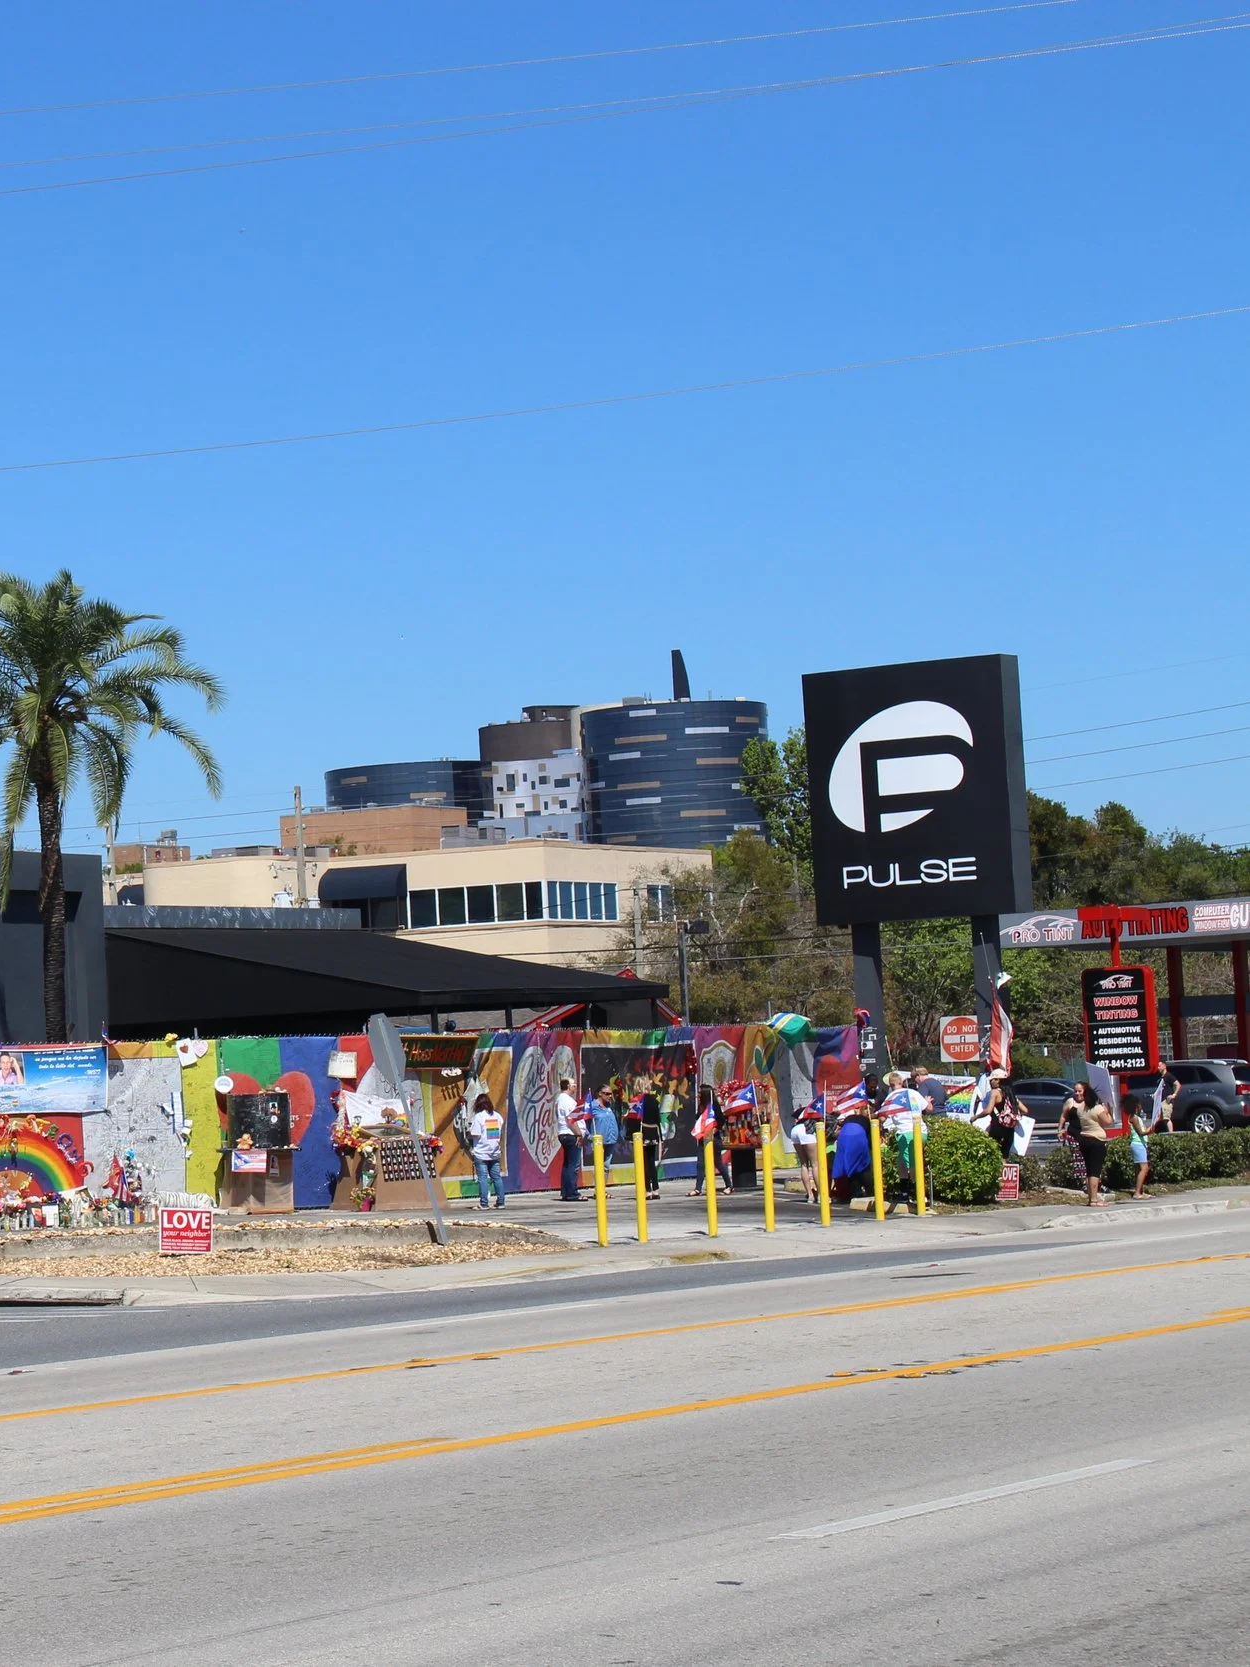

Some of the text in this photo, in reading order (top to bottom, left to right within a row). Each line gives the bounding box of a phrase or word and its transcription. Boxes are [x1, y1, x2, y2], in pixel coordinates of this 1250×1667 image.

[842, 856, 978, 890] PULSE
[1194, 905, 1230, 917] COMPUTER
[1230, 904, 1250, 927] CU
[1011, 927, 1074, 943] PRO TINT
[1093, 995, 1138, 1007] WINDOW
[1095, 1008, 1138, 1020] TINTING
[1098, 1026, 1141, 1034] AUTOMOTIVE
[1098, 1037, 1142, 1045] RESIDENTIAL
[950, 1045, 975, 1053] ENTER
[1099, 1047, 1143, 1055] COMMERCIAL
[1096, 1059, 1145, 1068] 407-841-2123
[1002, 1167, 1017, 1180] OVE
[163, 1211, 210, 1229] LOVE
